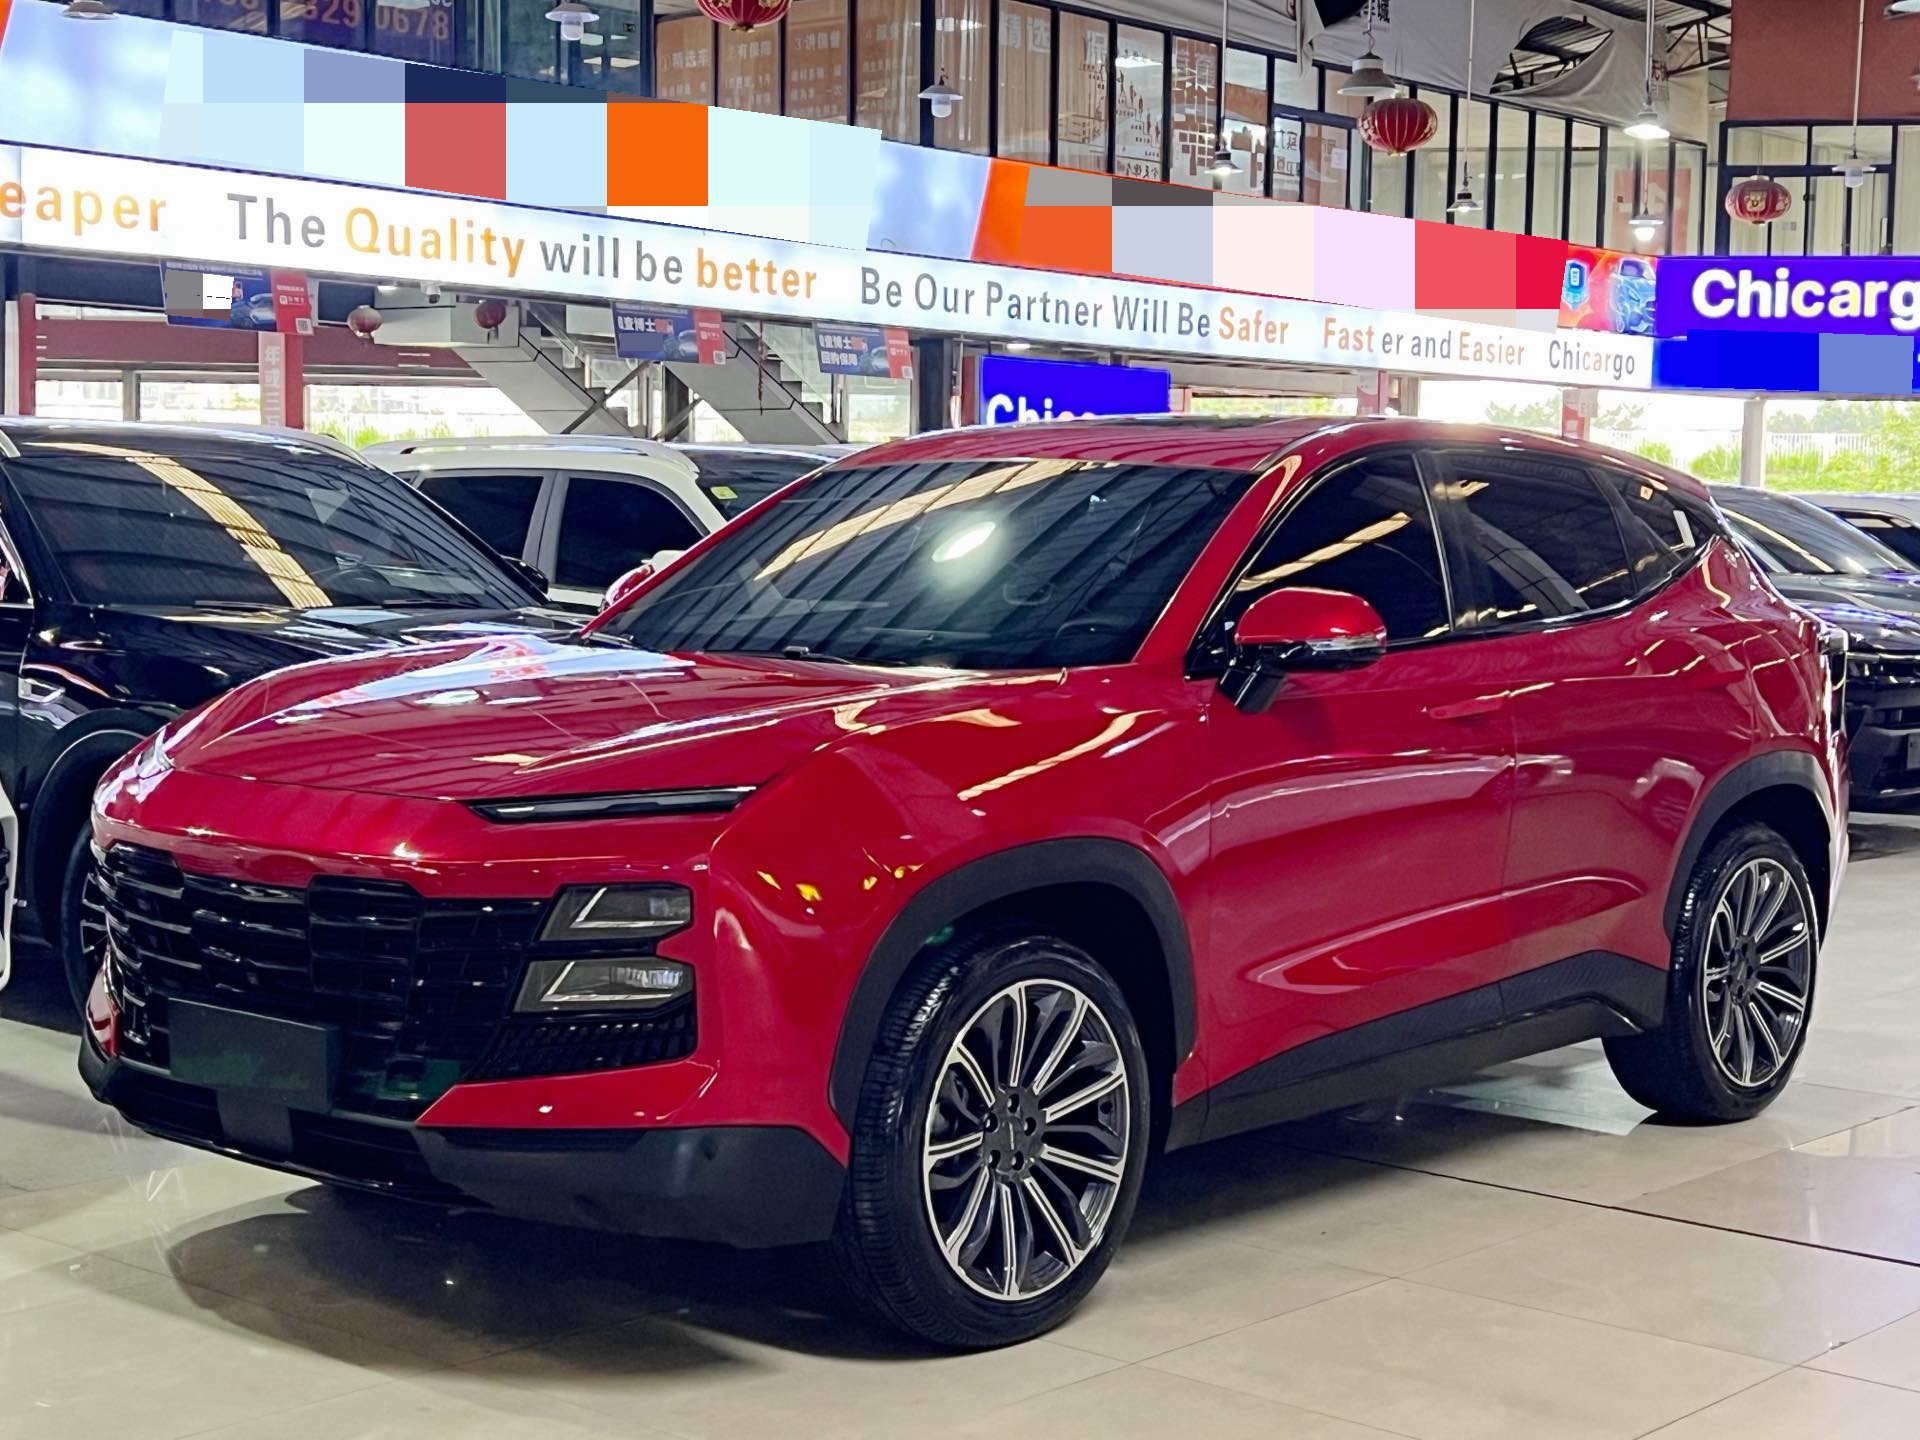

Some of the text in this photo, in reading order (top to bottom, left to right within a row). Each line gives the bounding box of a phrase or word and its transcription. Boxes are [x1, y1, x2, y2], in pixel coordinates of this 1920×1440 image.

[227, 193, 325, 249] The
[345, 207, 525, 278] Quality
[540, 234, 619, 278] will
[636, 240, 683, 284] be
[697, 248, 817, 298] better
[861, 267, 902, 308] Be
[915, 273, 975, 315] Our
[986, 281, 1102, 327] Partner
[1113, 295, 1168, 334] Will
[1178, 302, 1210, 337] Be
[1218, 306, 1289, 344] Safer
[1411, 330, 1452, 359] and
[1459, 331, 1525, 365] Easier
[1549, 340, 1635, 378] Chicargo
